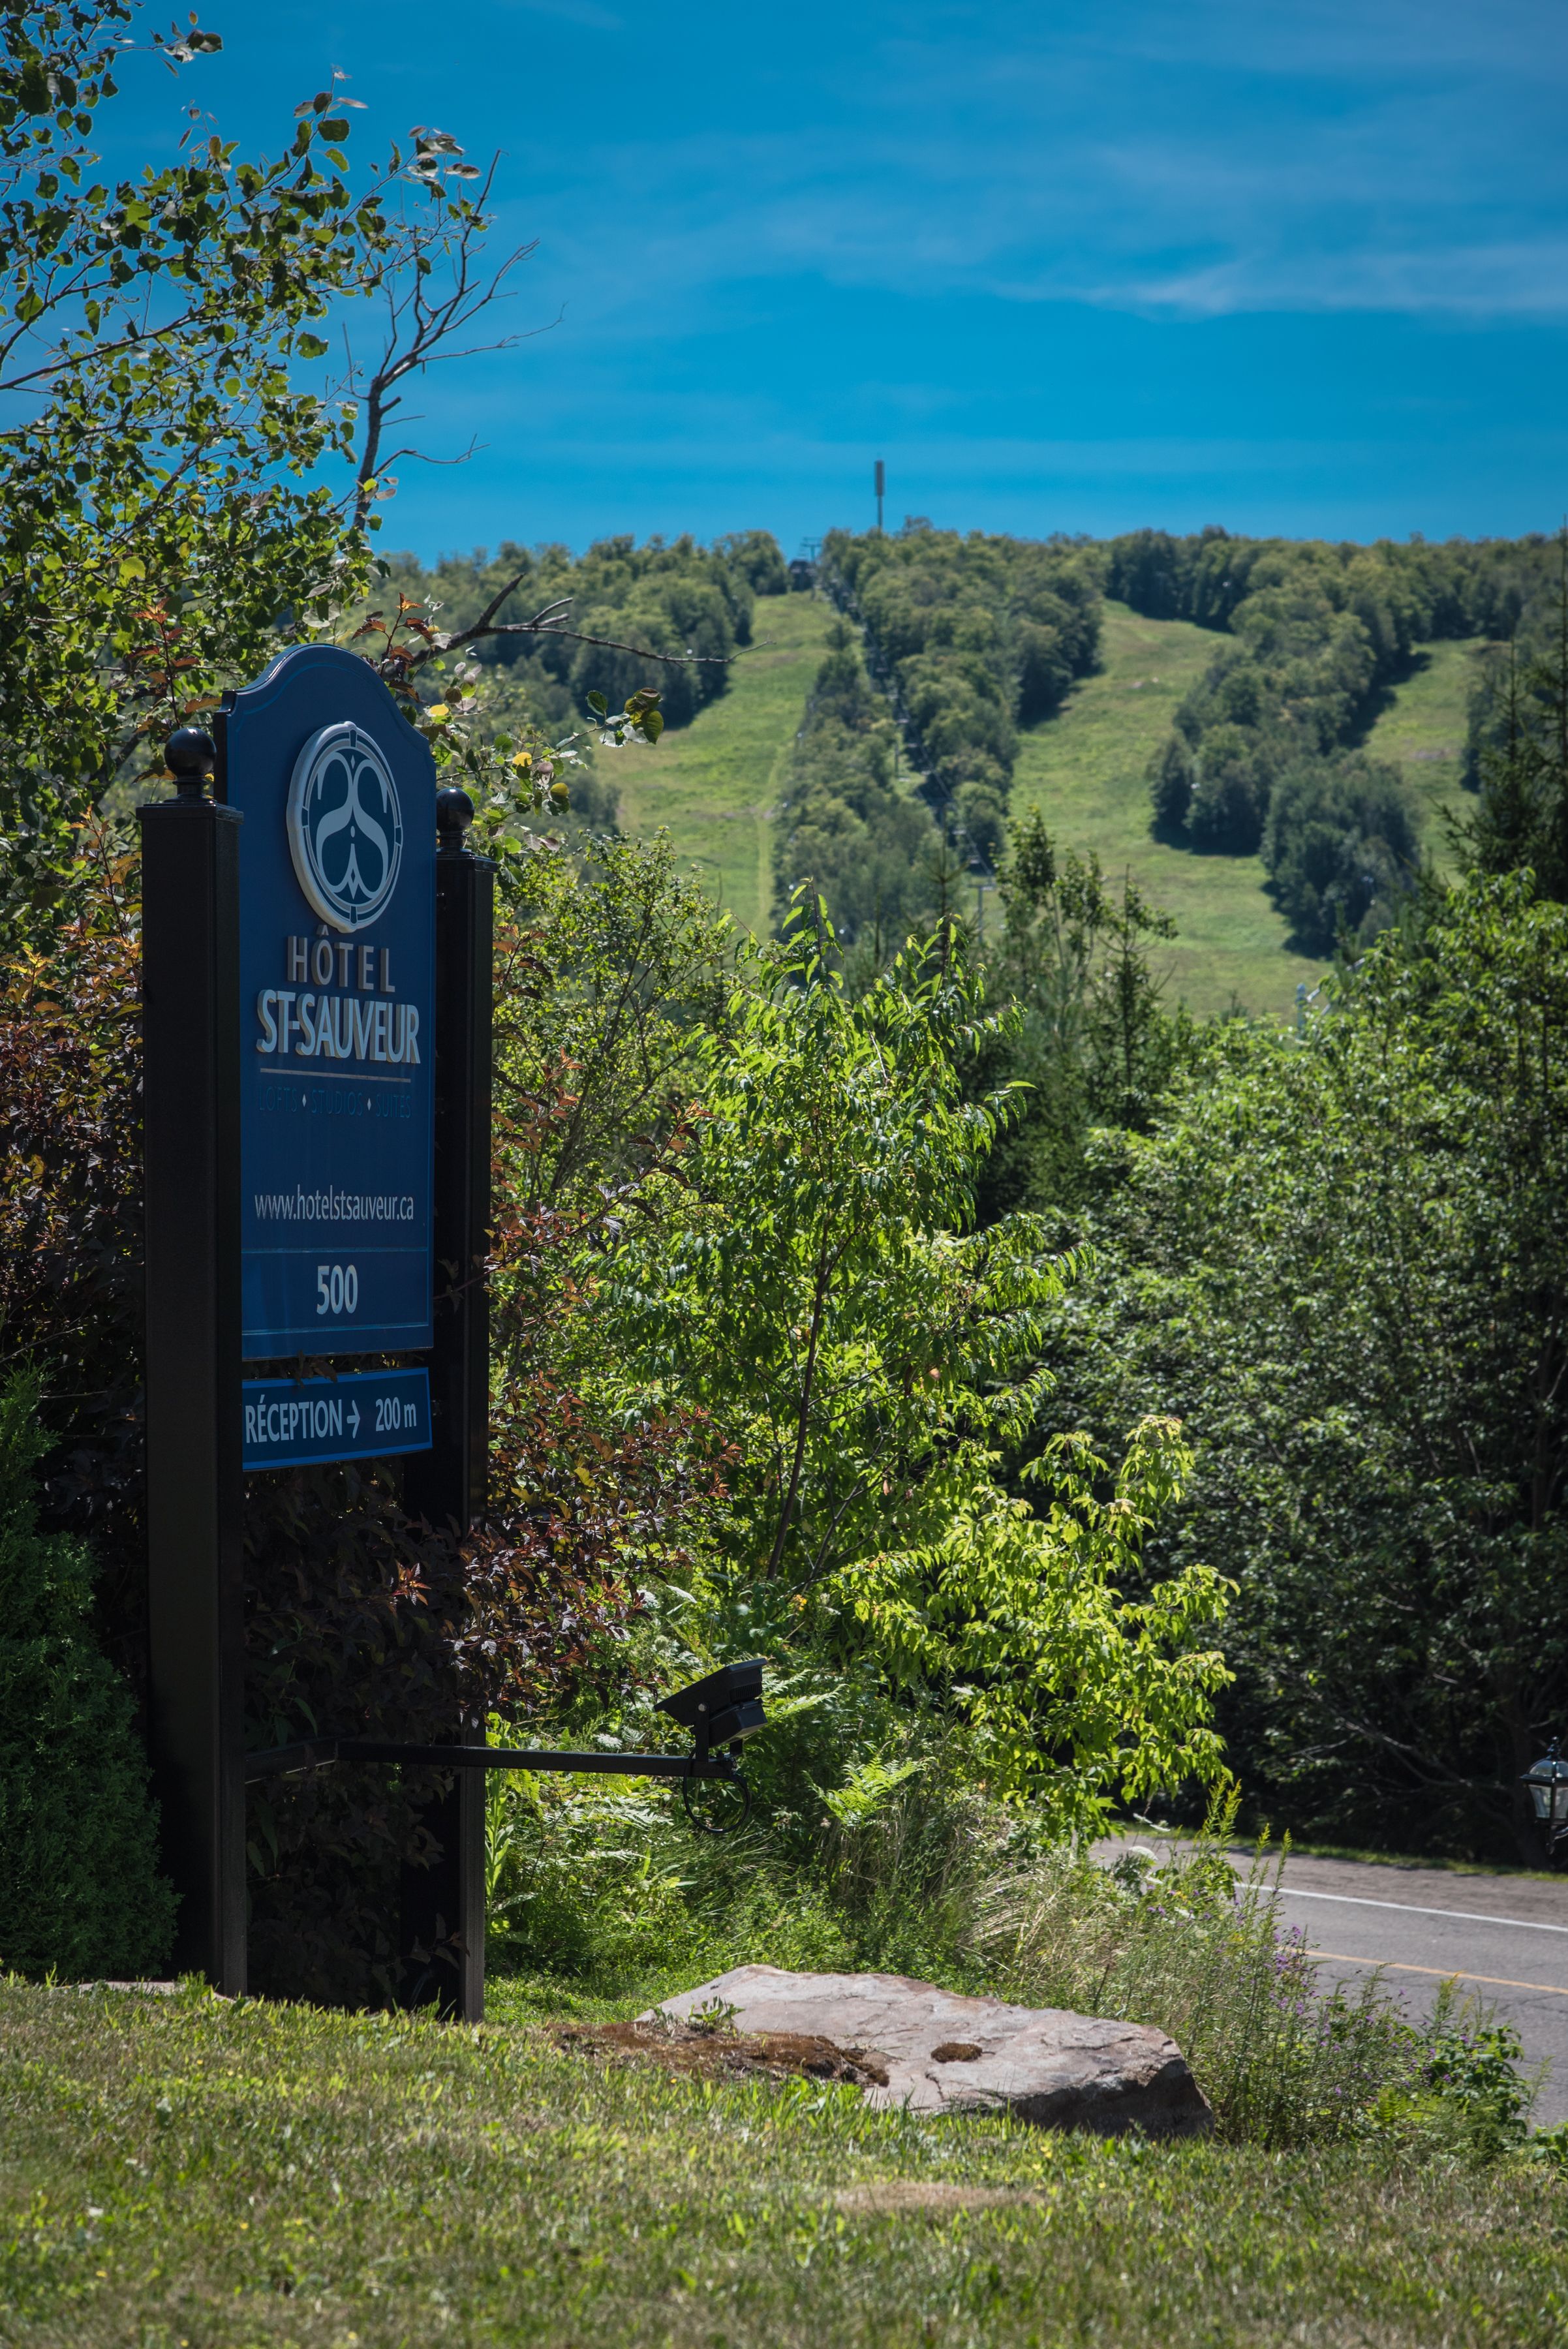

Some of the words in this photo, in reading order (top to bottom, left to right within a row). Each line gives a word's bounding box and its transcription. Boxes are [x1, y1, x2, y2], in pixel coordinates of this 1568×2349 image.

[287, 925, 395, 992] HÔTEL
[260, 1084, 297, 1113] LOFTS
[311, 1089, 363, 1116] STUDIOS
[375, 1094, 411, 1118] SUITES
[254, 1184, 414, 1221] www.hotelstsauveur.ca
[316, 1264, 358, 1315] 500
[245, 1394, 343, 1444] RÉCEPTION
[375, 1396, 401, 1432] 200
[404, 1402, 418, 1428] m
